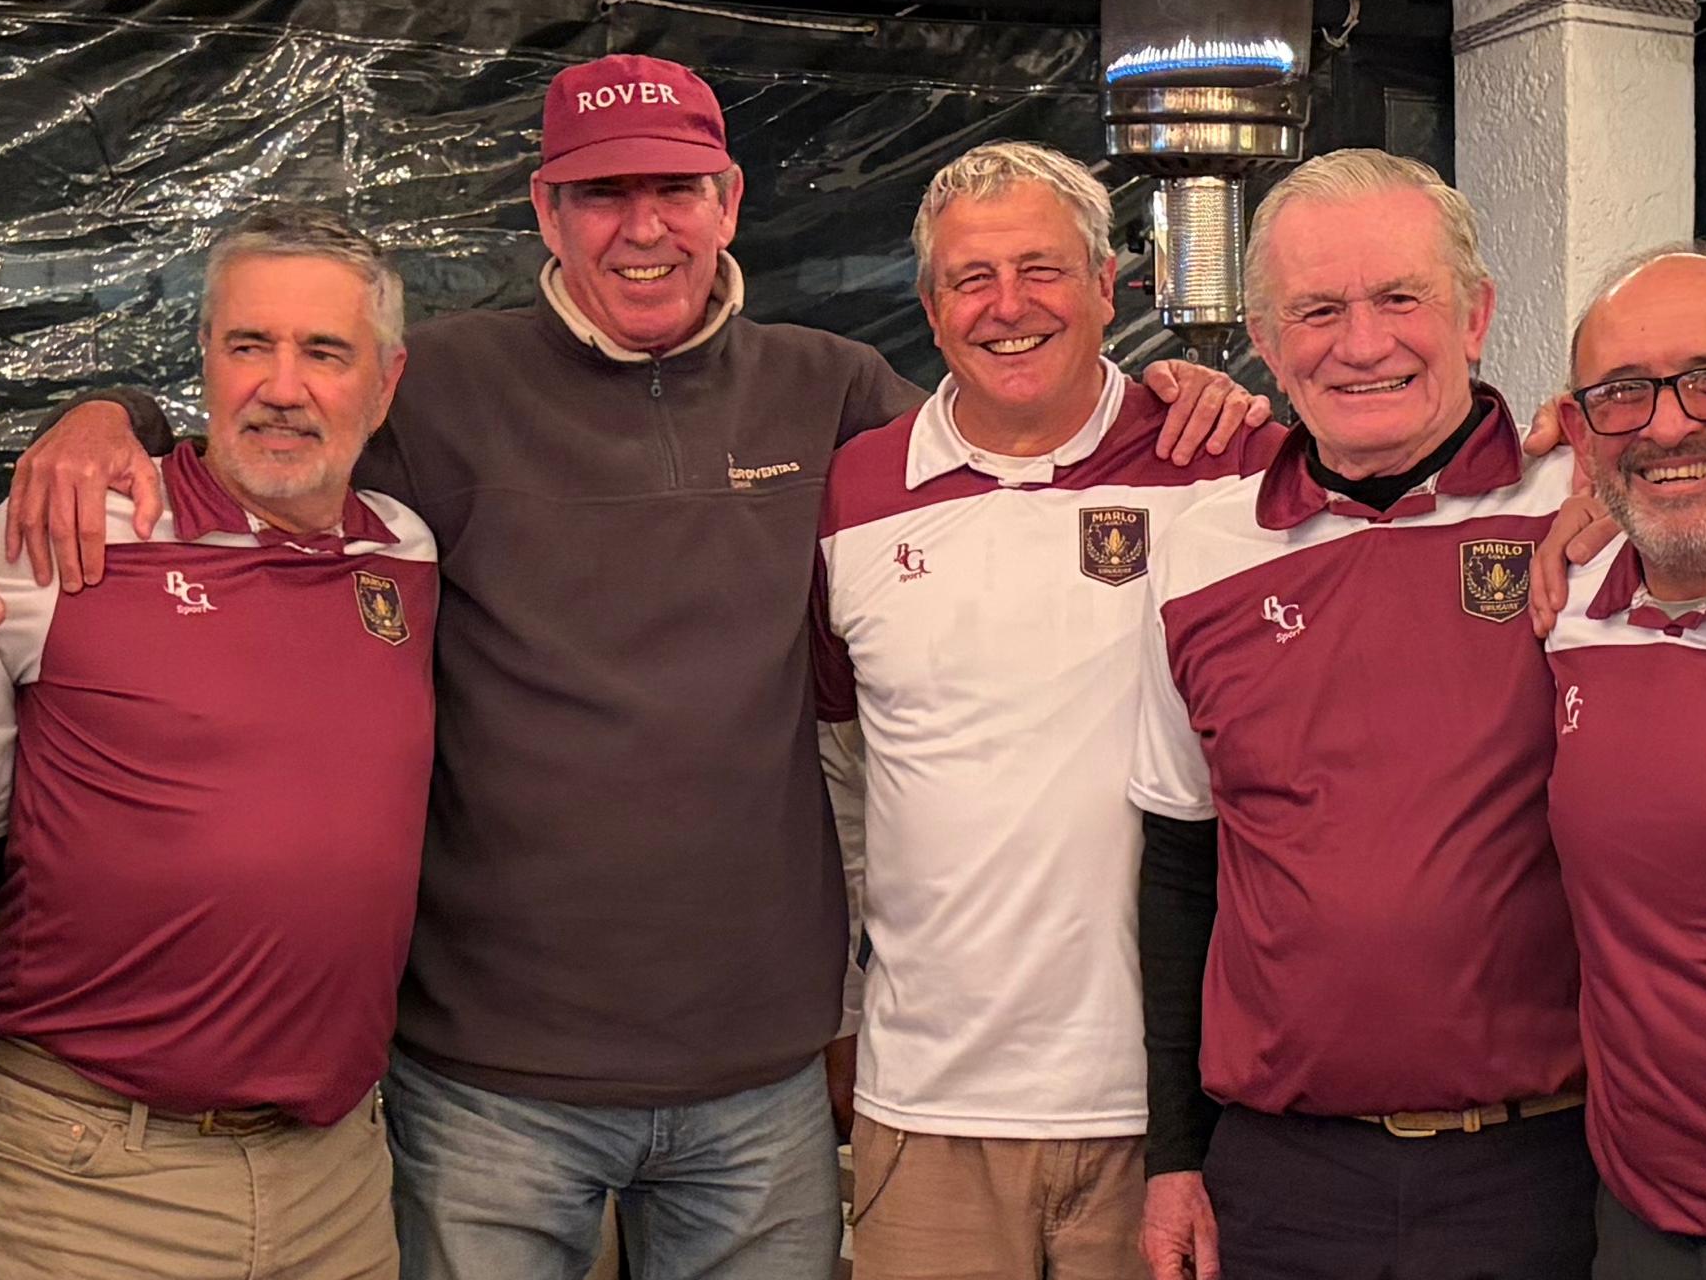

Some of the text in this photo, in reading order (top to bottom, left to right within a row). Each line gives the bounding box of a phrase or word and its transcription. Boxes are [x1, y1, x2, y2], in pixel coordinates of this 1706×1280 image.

[576, 81, 681, 114] ROVER
[1092, 511, 1137, 524] MARLO
[1473, 543, 1523, 557] MARLO
